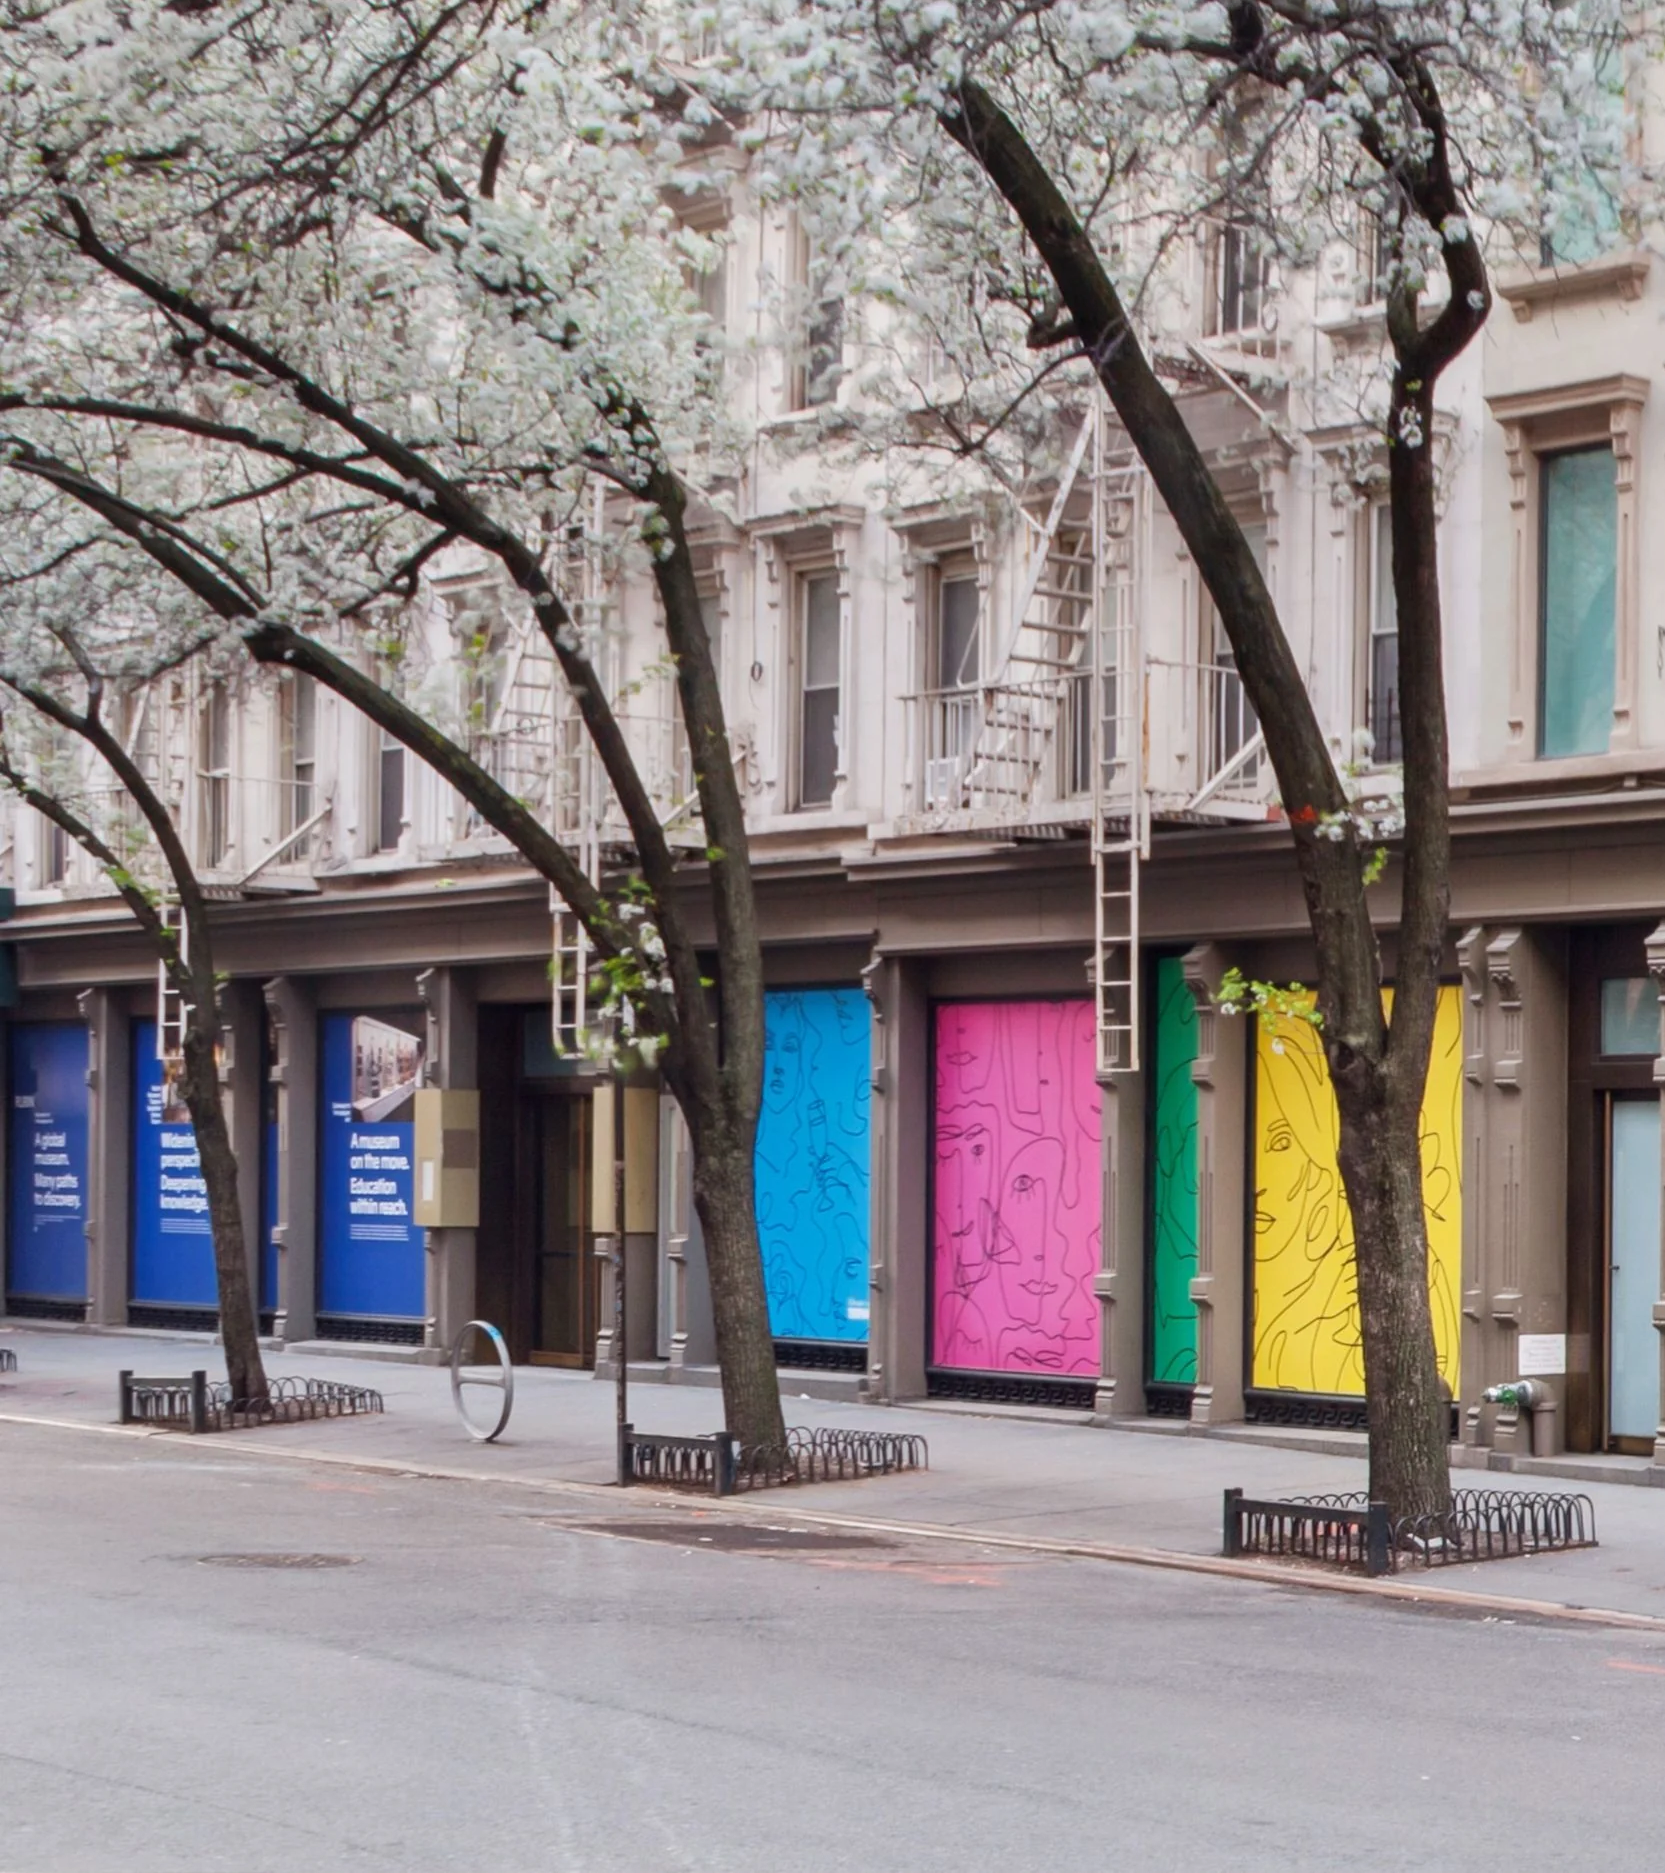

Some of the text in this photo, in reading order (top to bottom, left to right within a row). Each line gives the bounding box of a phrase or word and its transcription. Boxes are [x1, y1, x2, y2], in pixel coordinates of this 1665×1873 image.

[350, 1132, 359, 1150] A
[351, 1156, 363, 1169] on
[364, 1153, 380, 1169] the
[350, 1177, 397, 1194] Education
[350, 1198, 378, 1214] within
